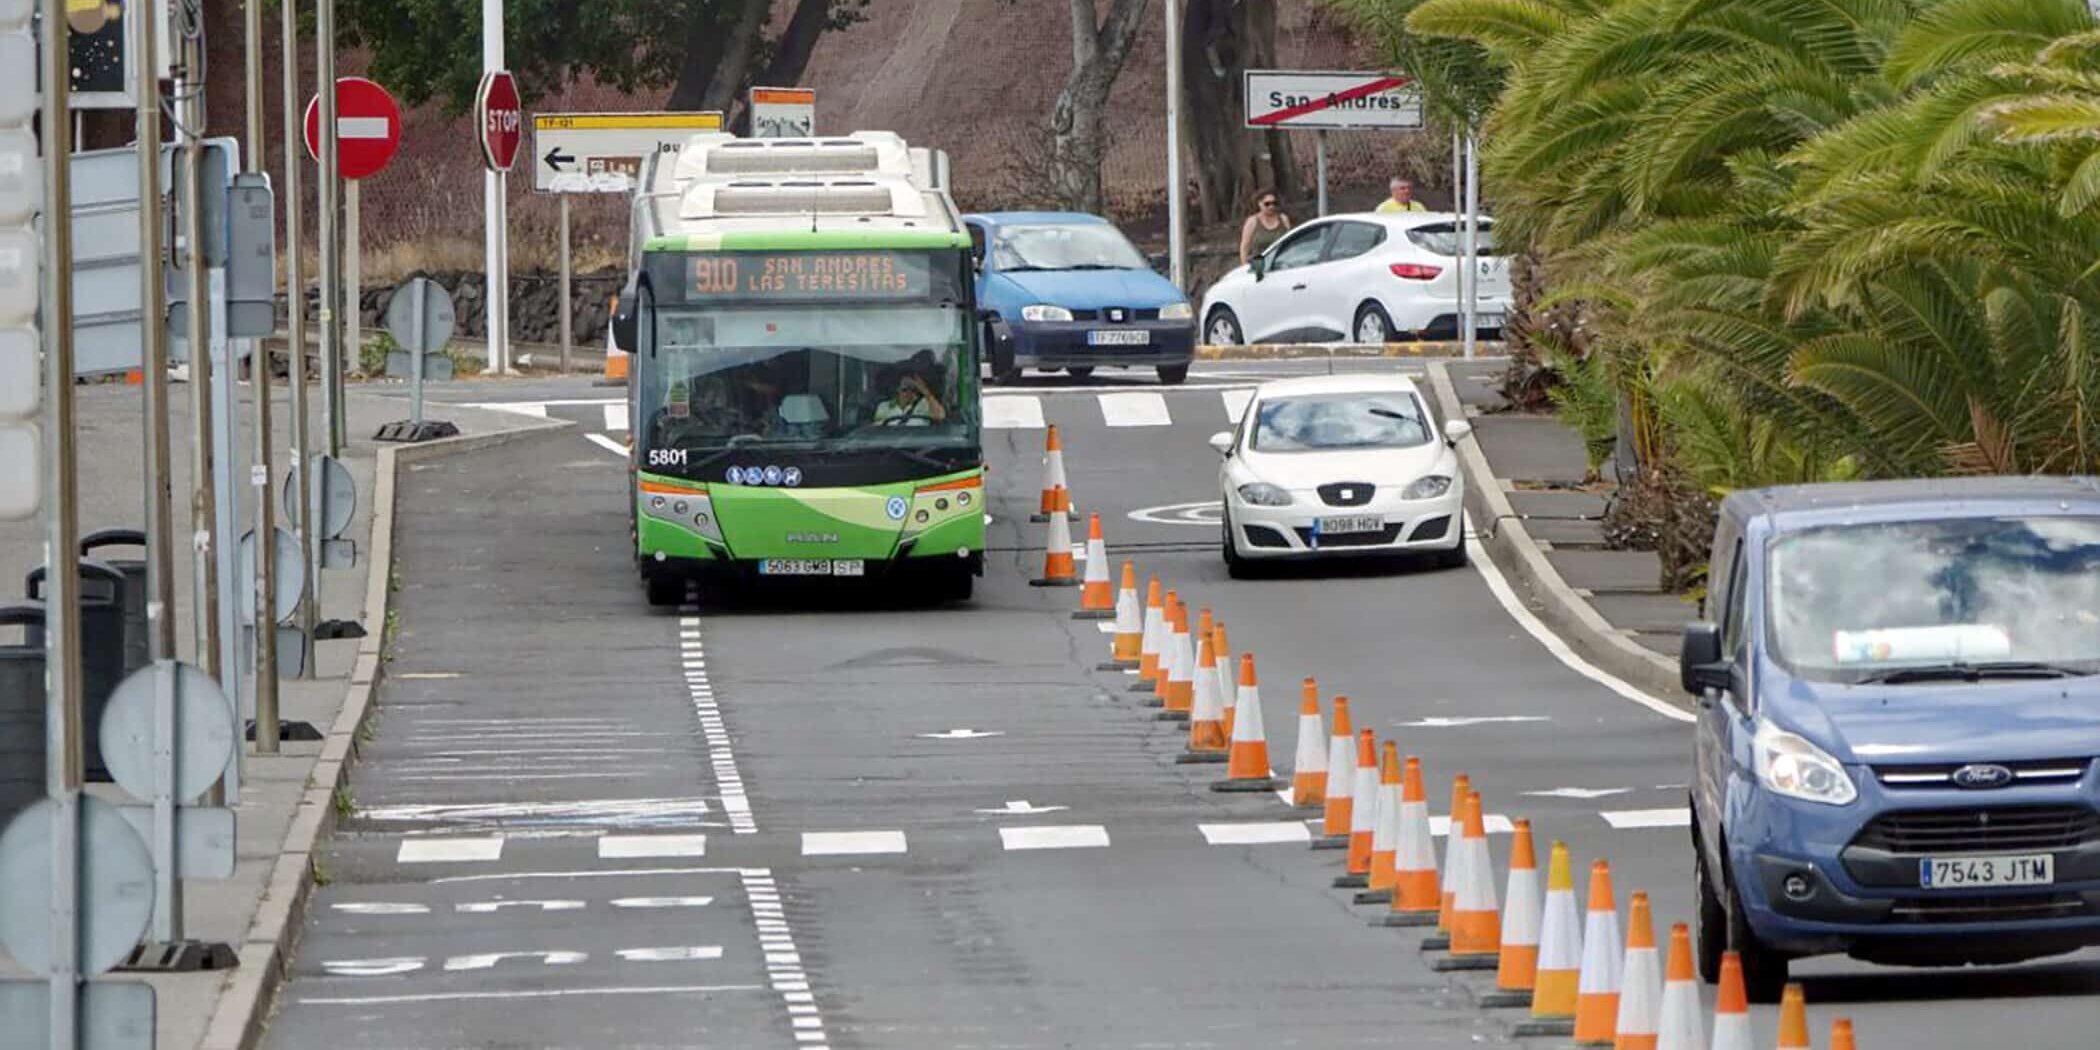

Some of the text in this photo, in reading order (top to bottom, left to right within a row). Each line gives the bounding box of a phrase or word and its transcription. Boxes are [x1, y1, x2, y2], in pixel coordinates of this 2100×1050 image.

[1269, 91, 1310, 108] San
[488, 108, 518, 133] STOP
[765, 256, 893, 274] SAN ANDRES
[696, 257, 737, 293] 910
[750, 273, 907, 291] LAS TERESITAS
[649, 448, 688, 465] 5801
[1936, 859, 2046, 881] 7543 JTM
